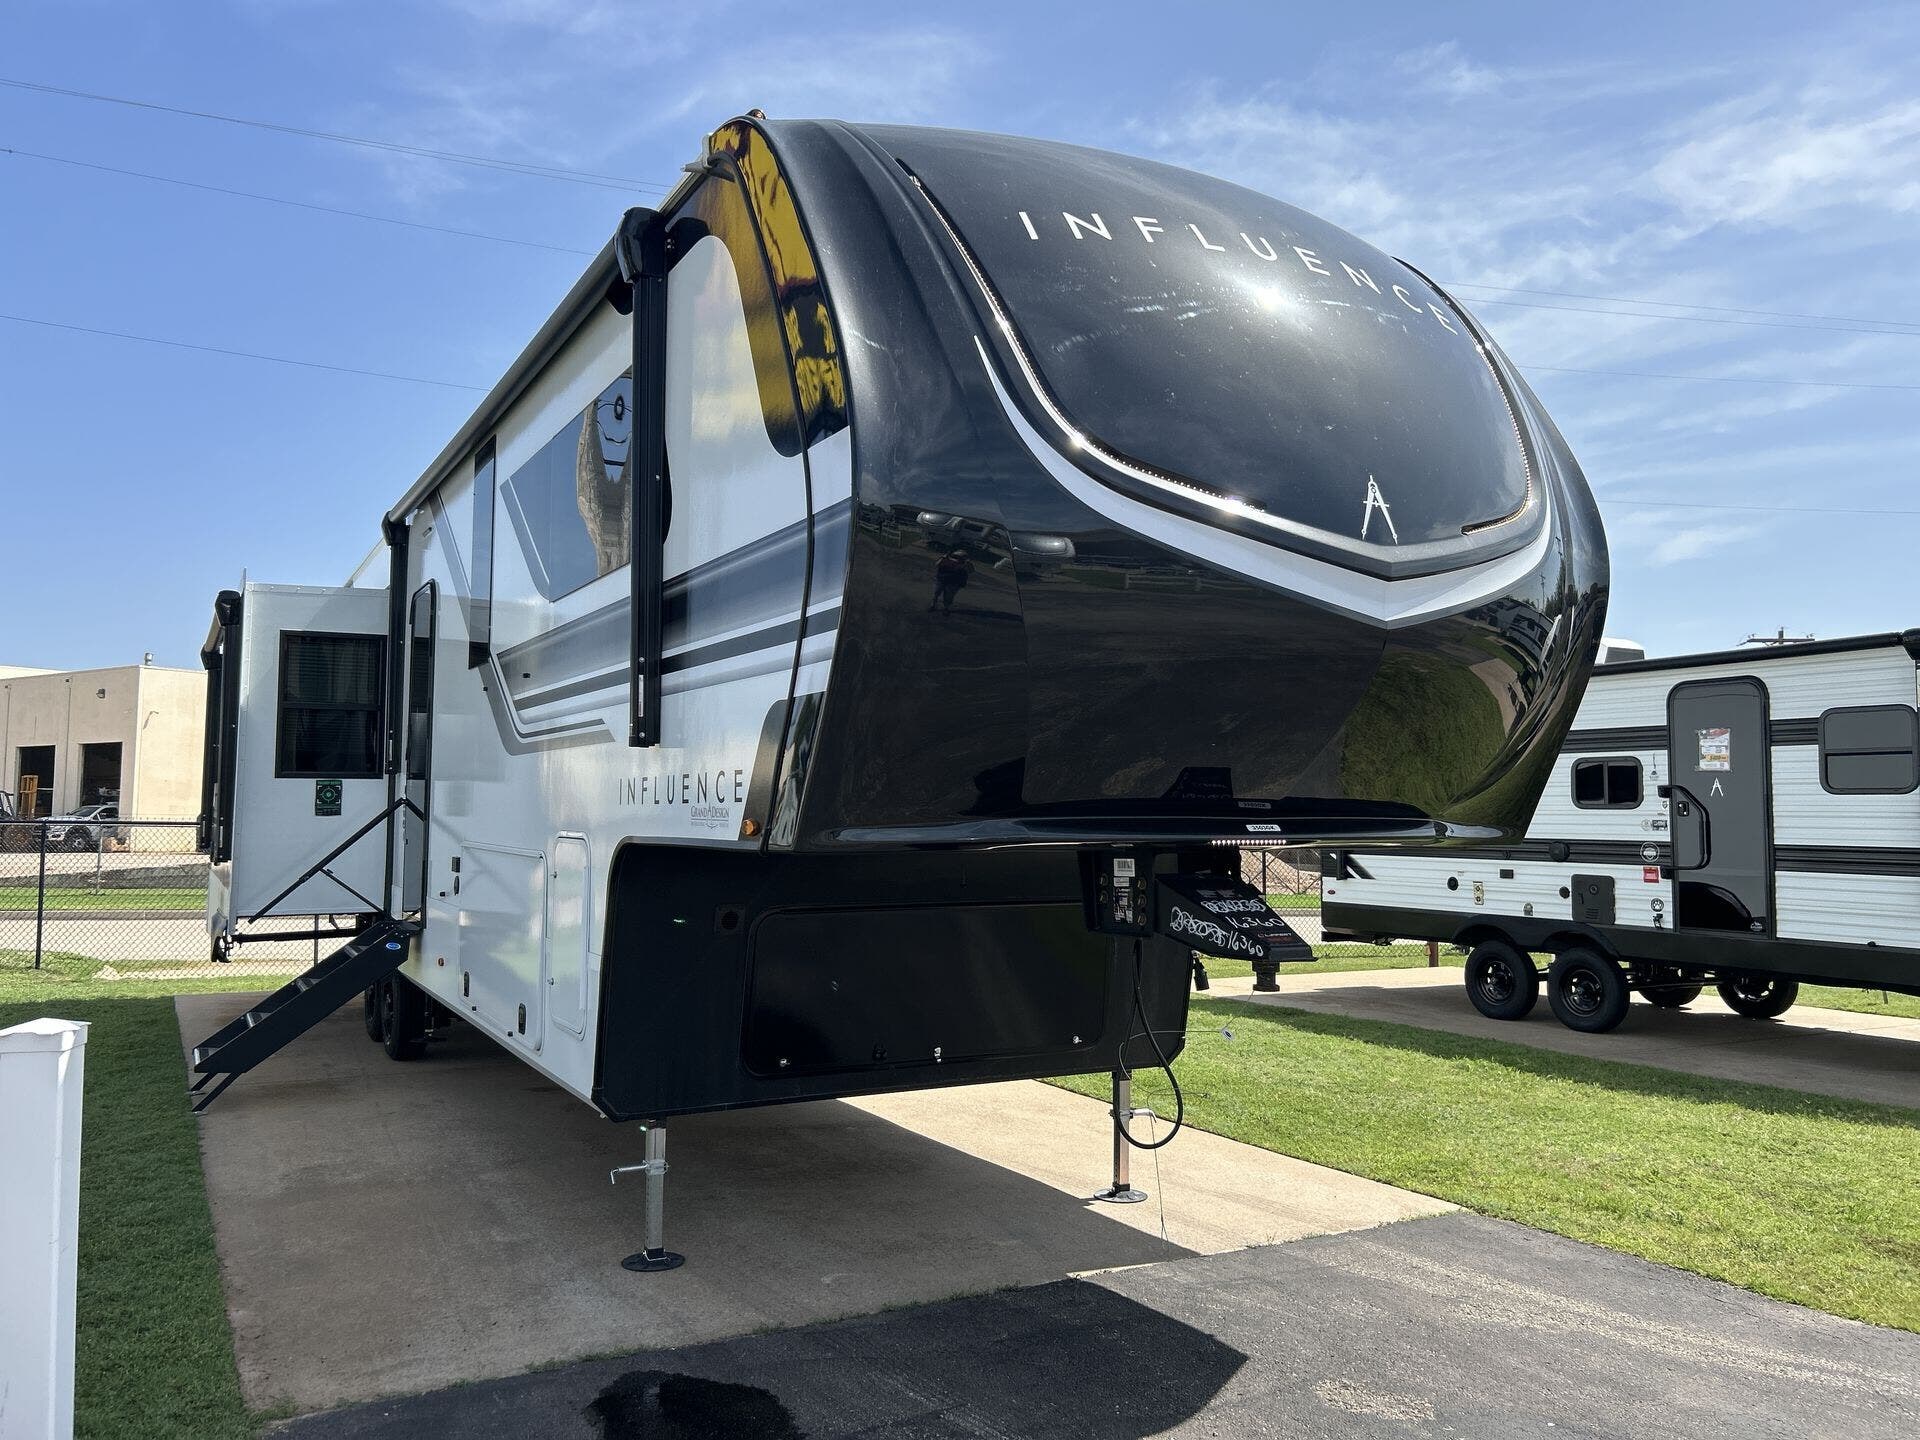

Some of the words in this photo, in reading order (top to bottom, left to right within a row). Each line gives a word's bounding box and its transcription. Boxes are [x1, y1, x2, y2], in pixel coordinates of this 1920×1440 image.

[1018, 211, 1459, 335] INFLUENCE
[618, 769, 743, 805] INFLUENCE
[690, 805, 708, 818] GRAND
[711, 805, 730, 818] DESIGN
[1225, 916, 1285, 929] 16360
[1227, 930, 1264, 957] 16360
